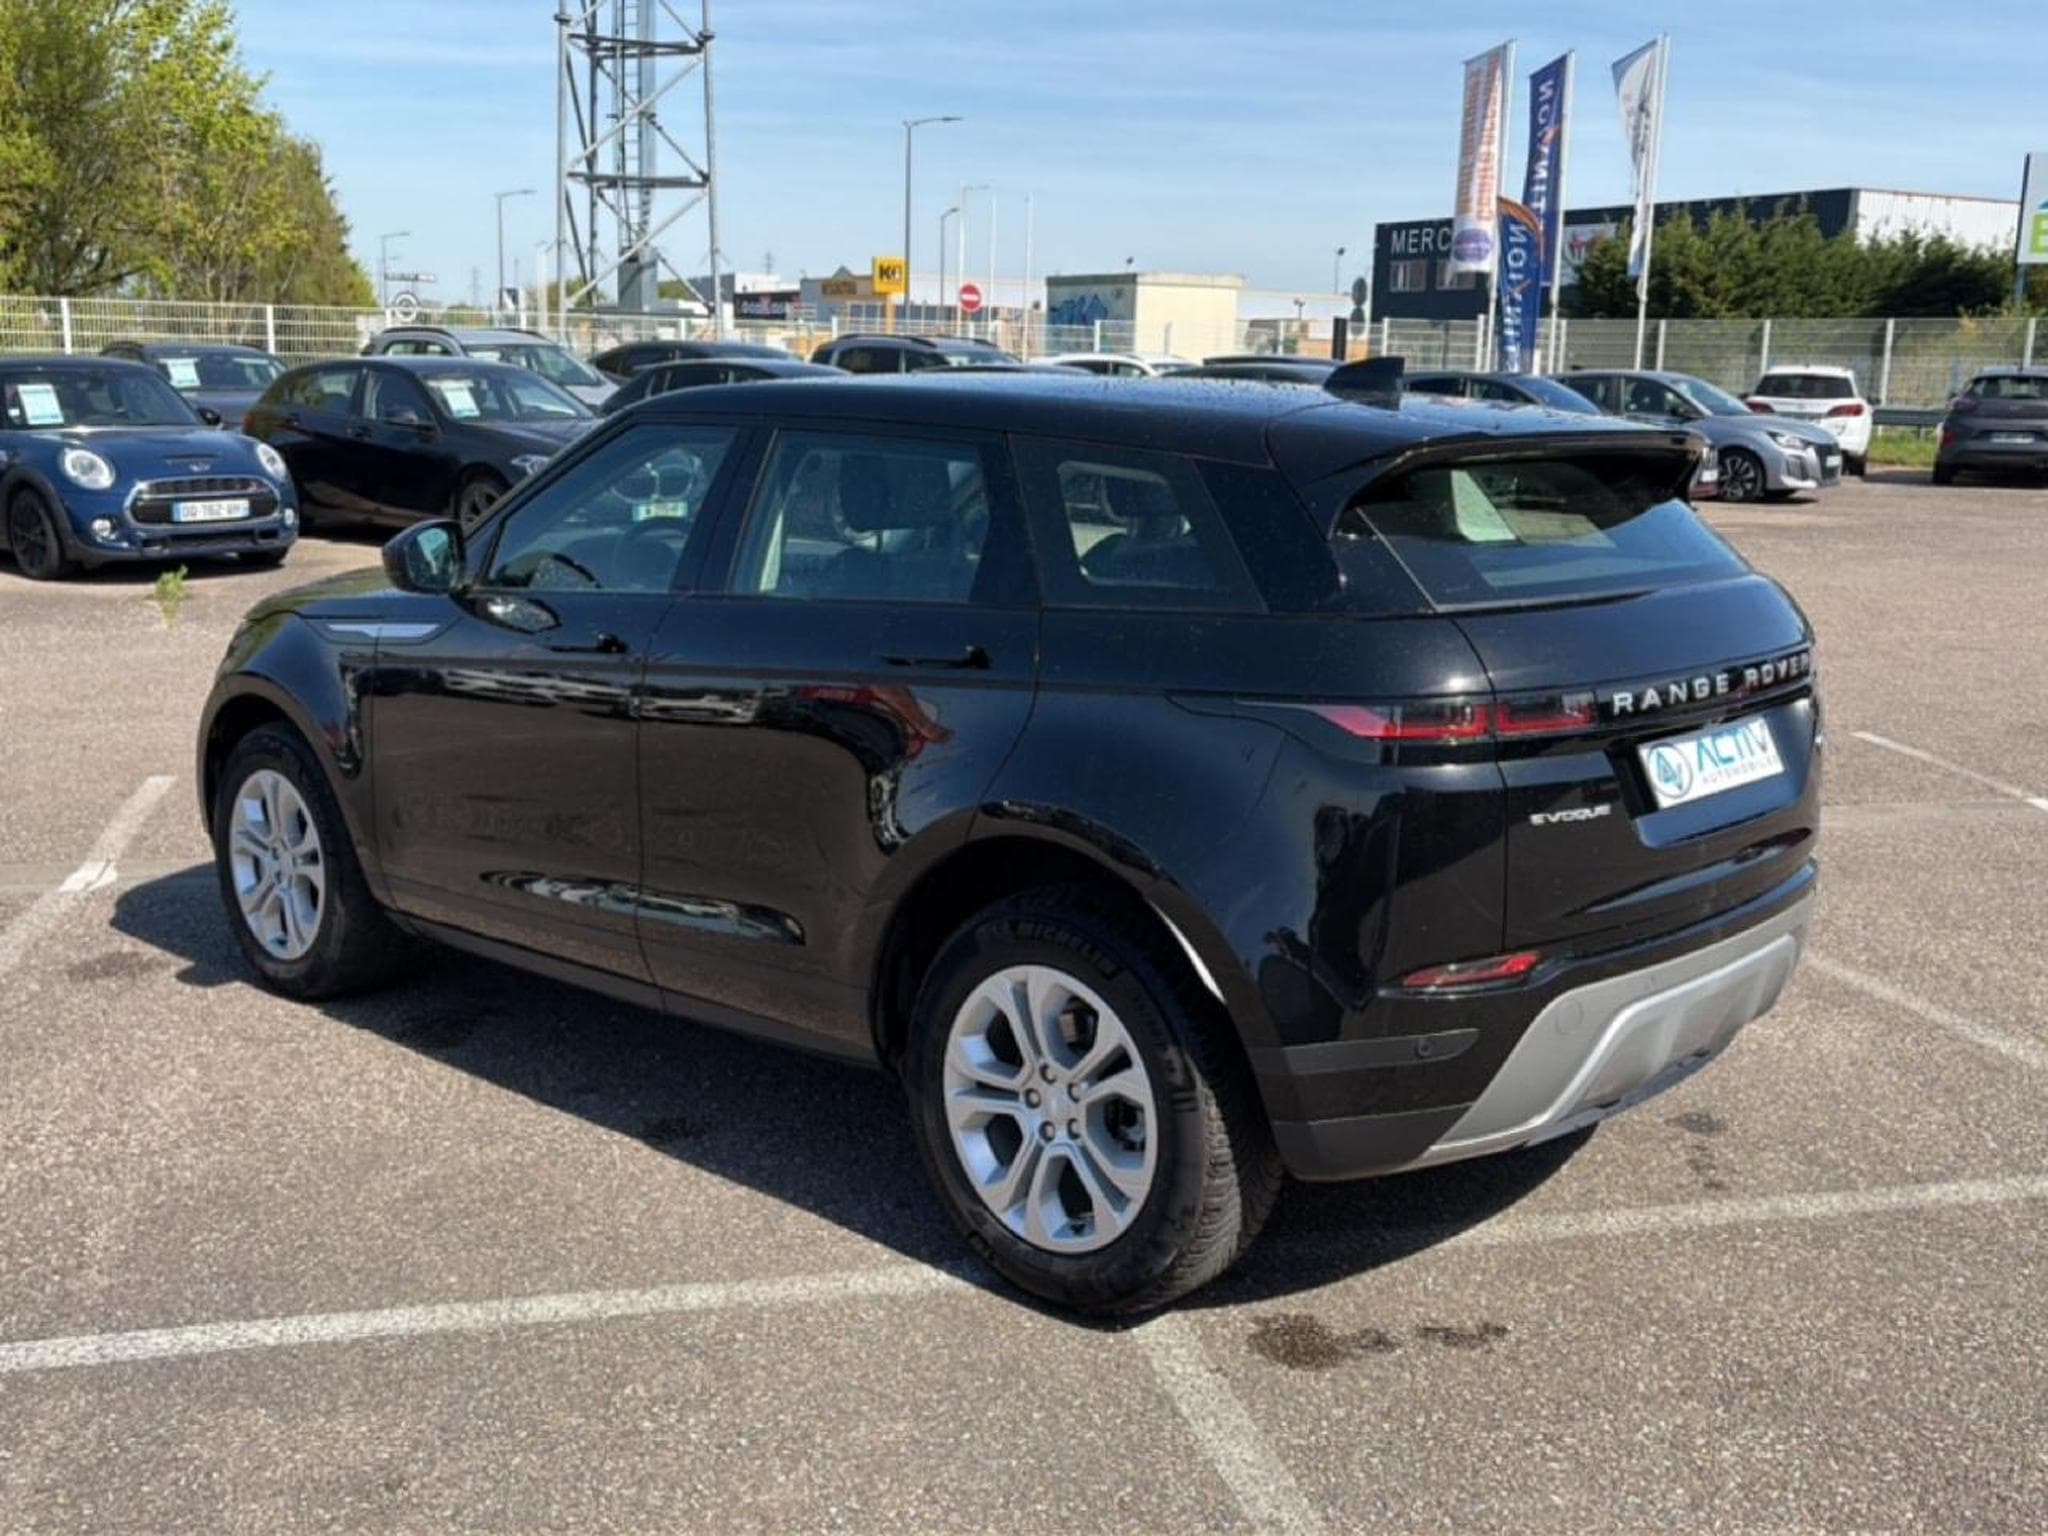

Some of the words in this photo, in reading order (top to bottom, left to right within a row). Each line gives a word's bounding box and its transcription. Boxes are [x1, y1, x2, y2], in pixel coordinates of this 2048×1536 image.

[1391, 227, 1450, 255] MERC
[1613, 673, 1730, 716] RANGE
[1744, 653, 1809, 689] ROVER
[1697, 720, 1769, 771] ACTIV
[1530, 803, 1611, 827] EVOQUE
